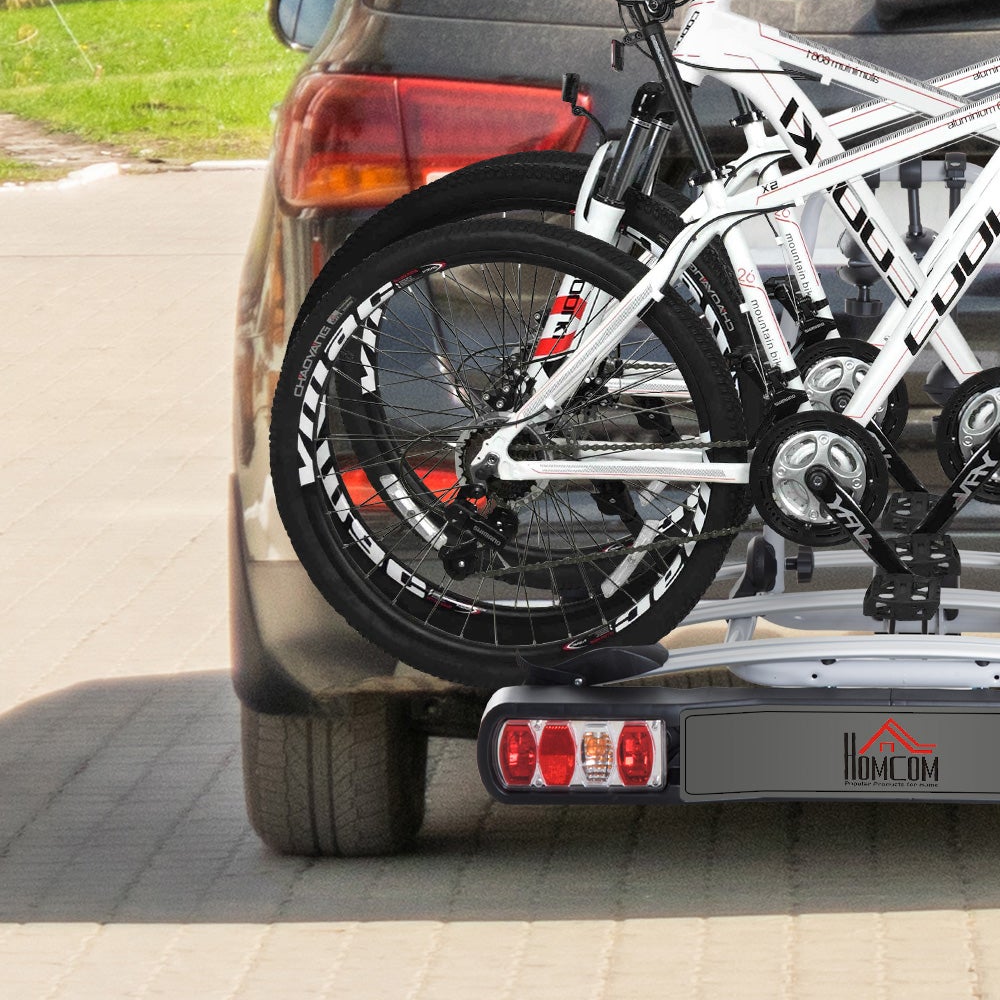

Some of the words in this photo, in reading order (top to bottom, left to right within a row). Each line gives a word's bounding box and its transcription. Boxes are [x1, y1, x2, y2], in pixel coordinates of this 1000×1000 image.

[948, 104, 996, 130] aluminium
[785, 232, 806, 281] mountain
[750, 299, 775, 352] mountain
[294, 324, 332, 397] CHAOYANG
